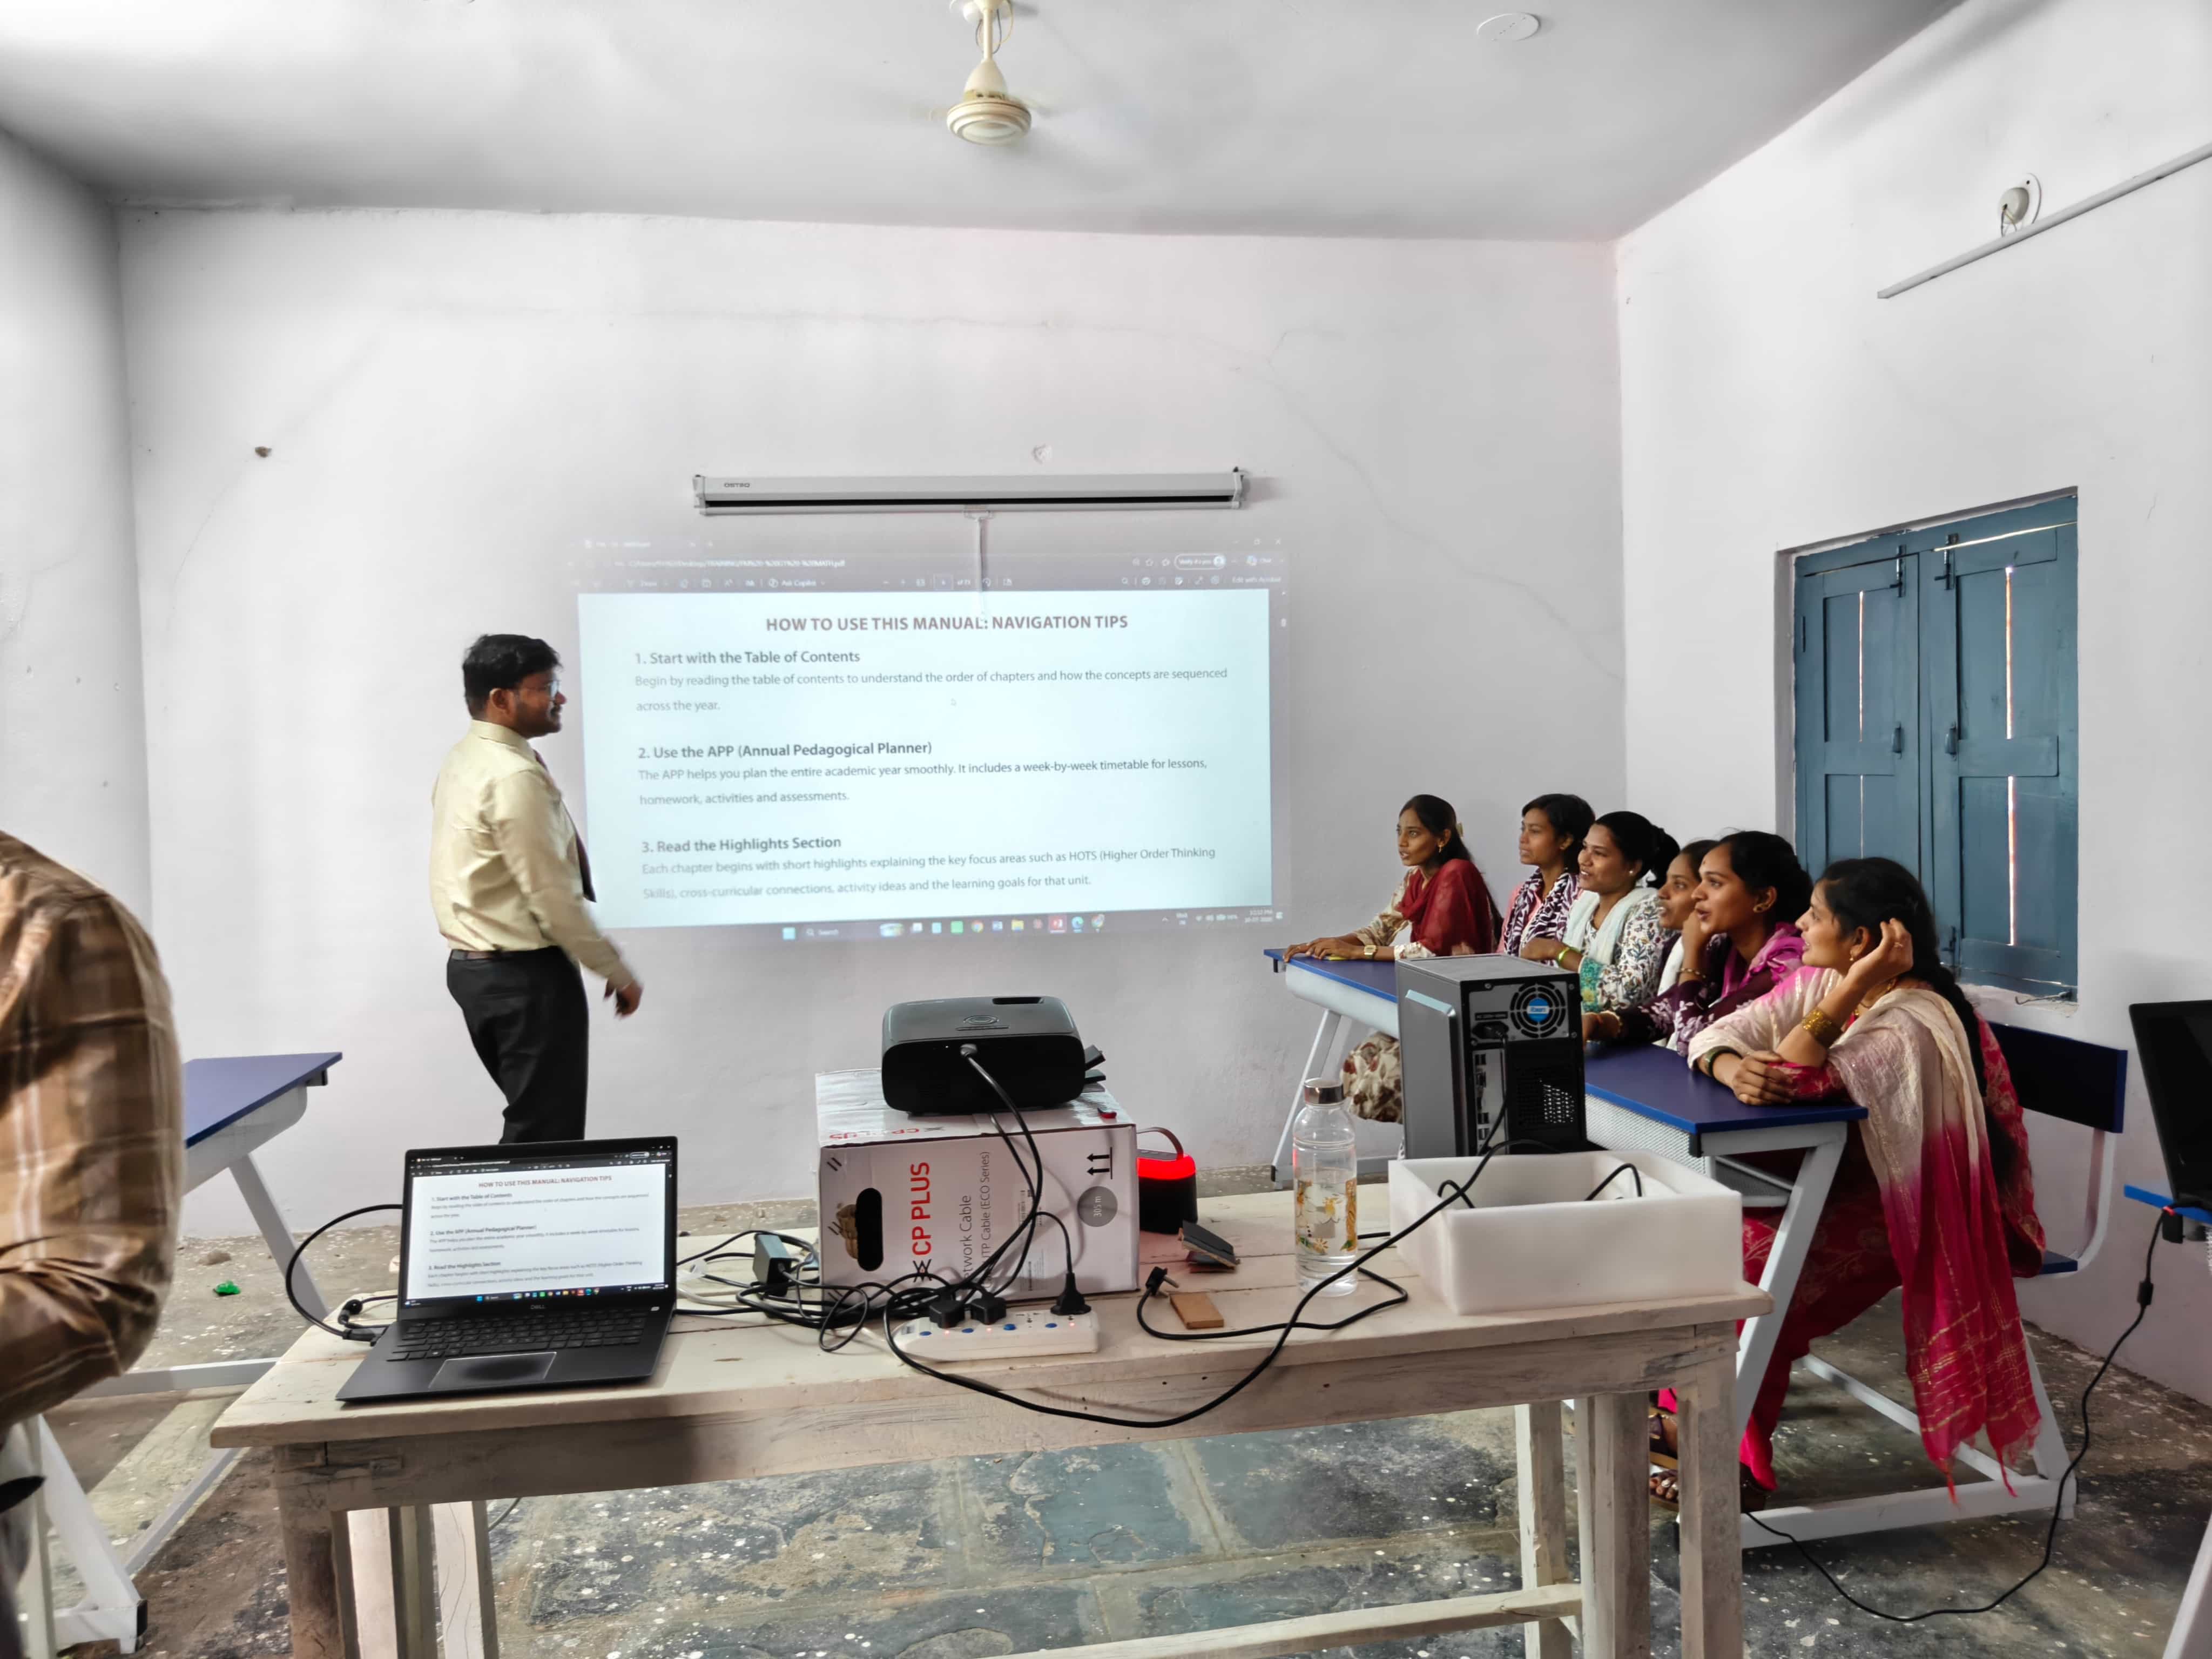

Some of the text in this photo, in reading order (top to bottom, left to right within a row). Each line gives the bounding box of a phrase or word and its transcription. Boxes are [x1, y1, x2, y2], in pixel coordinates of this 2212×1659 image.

[765, 615, 1129, 631] HOW TO USE THIS MANUAL: NAVIGATION TIPS
[635, 651, 861, 665] 1. Start with the Table of Contents
[635, 668, 1228, 689] Begin by reading the table of contents to understand the order of chapters and how the concepts are sequenced
[636, 700, 721, 713] across the year.
[638, 741, 933, 759] 2. Use the APP (Annual Pedagogical Planner)
[638, 769, 660, 780] The
[662, 769, 685, 780] APP
[686, 768, 718, 782] helps
[719, 770, 741, 781] you
[742, 767, 768, 780] plan
[769, 767, 789, 778] the
[790, 767, 823, 777] entire
[824, 765, 876, 777] academic
[878, 767, 902, 778] year
[903, 764, 956, 777] smoothly.
[958, 764, 966, 773] It
[968, 762, 1013, 773] includes
[1022, 760, 1098, 774] week-by-week
[1099, 759, 1150, 770] timetable
[1150, 758, 1166, 770] for
[1167, 758, 1208, 770] lessons,
[639, 792, 850, 806] homework, activities and assessments.
[641, 837, 842, 854] 3. Read the Highlights Section
[642, 847, 1216, 875] Each chapter begins with short highlights explaining the key focus areas such as HOTS (Higher Order Thinking
[643, 875, 1091, 900] Skills), cross-curricular connections, activity ideas and the learning goals for that unit.
[980, 1151, 990, 1183] Series)
[910, 1162, 932, 1256] CP PLUS
[979, 1185, 991, 1211] (ECO
[1093, 1196, 1102, 1218] 305 m
[959, 1195, 973, 1279] etwork Cable
[981, 1211, 992, 1241] Cable
